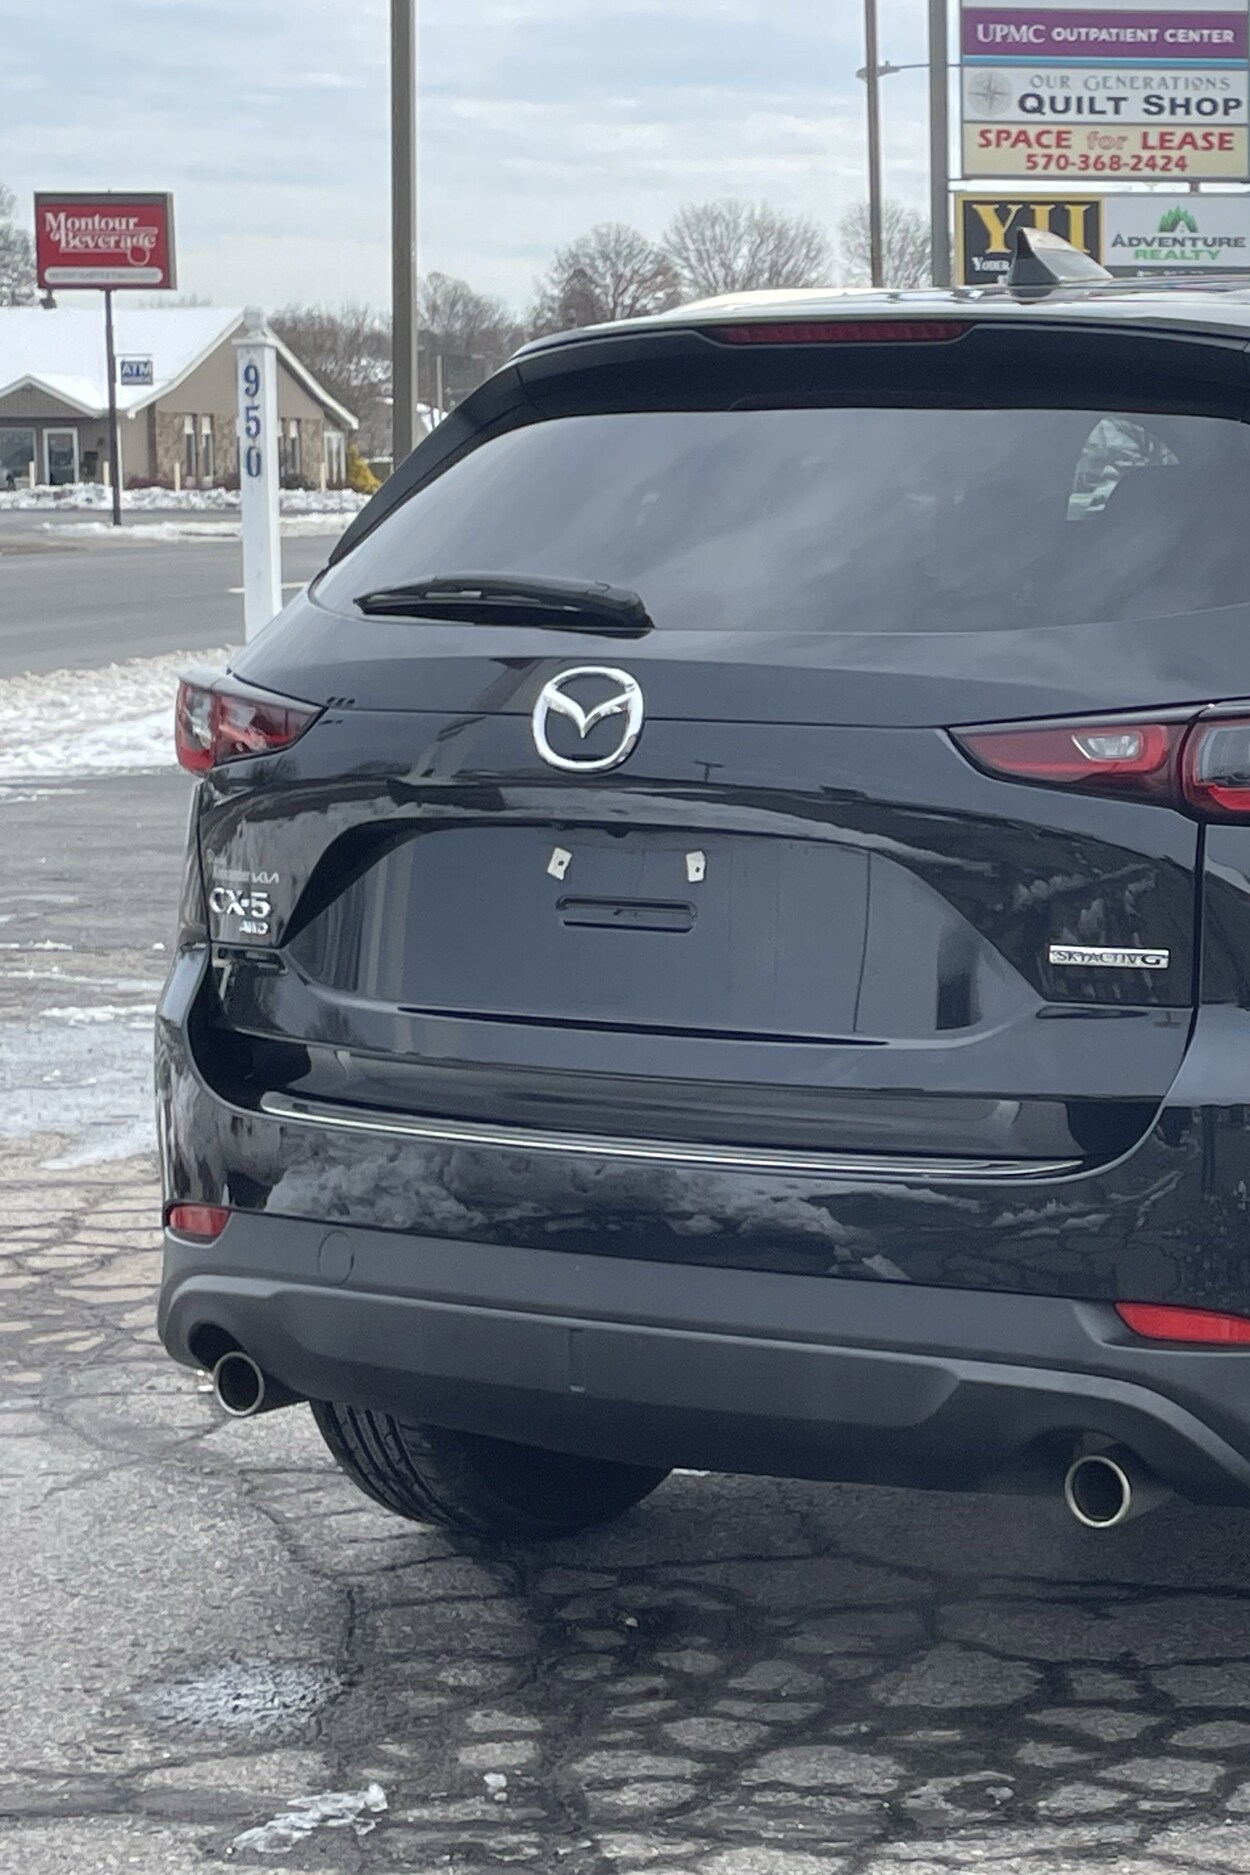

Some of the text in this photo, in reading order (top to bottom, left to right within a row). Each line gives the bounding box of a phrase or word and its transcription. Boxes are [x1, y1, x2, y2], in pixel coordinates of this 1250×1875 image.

[976, 23, 1234, 44] UPMC OUTPATIENT CENTER
[1029, 74, 1231, 92] OUR GENERATIONS
[1018, 93, 1243, 117] QUILT SHOP
[978, 129, 1235, 151] SPACE for LEASE
[1025, 154, 1189, 172] 570-368-2424
[45, 212, 139, 232] Montour
[50, 231, 156, 265] Beverage
[1111, 233, 1246, 249] ADVENTURE
[1133, 249, 1221, 261] REALTY
[122, 363, 152, 376] ATM
[243, 363, 262, 478] 950
[209, 887, 270, 918] CX-5
